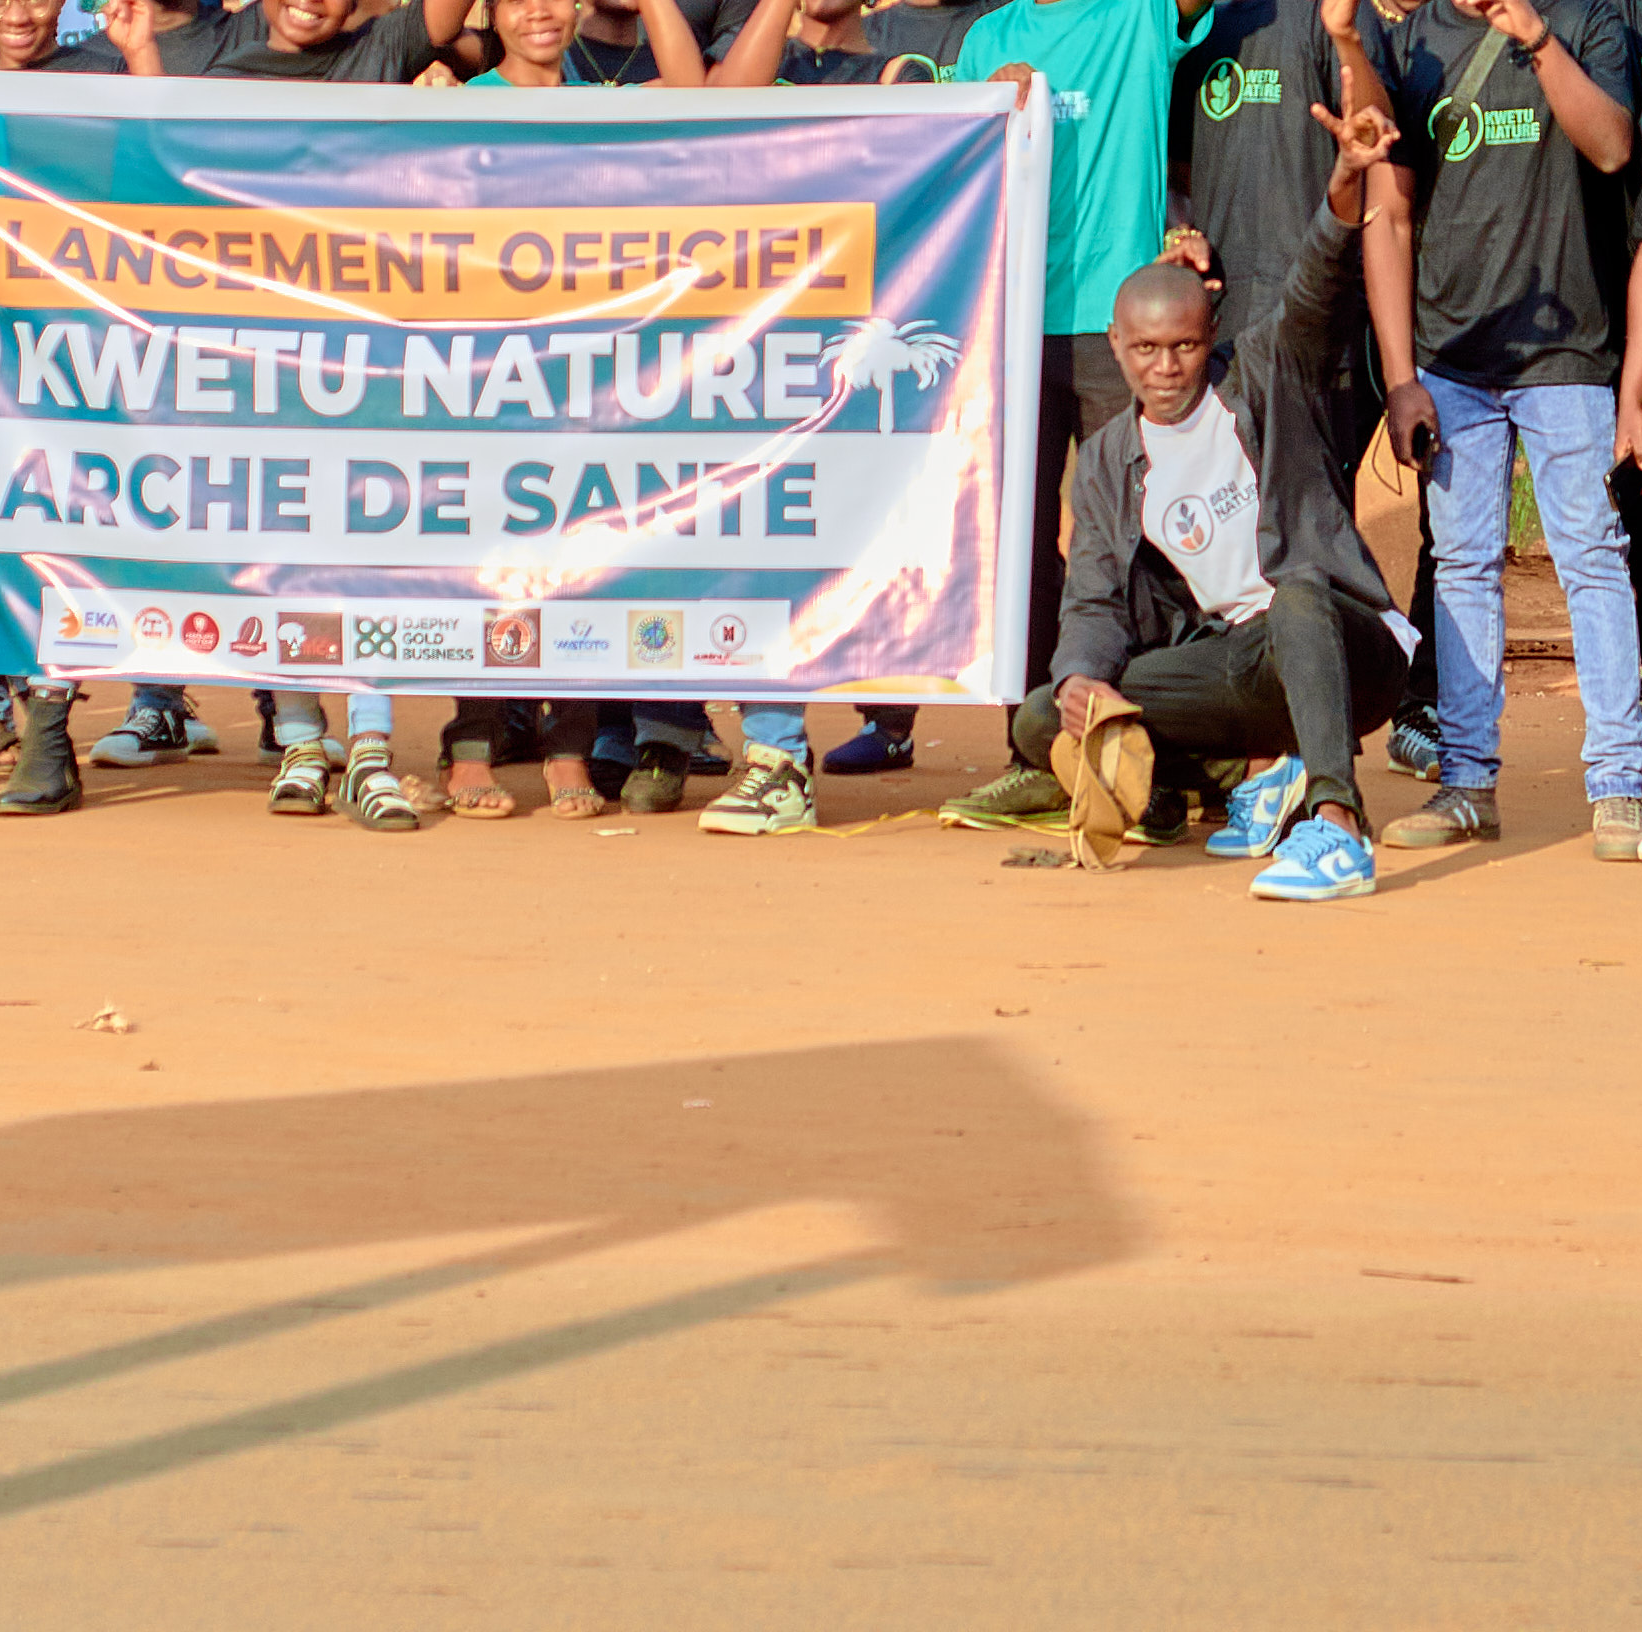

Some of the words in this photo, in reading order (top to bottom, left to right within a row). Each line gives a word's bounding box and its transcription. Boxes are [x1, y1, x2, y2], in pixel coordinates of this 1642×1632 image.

[1484, 108, 1534, 125] KWETU
[1485, 122, 1540, 140] NATURE
[6, 220, 475, 293] LANCEMENT
[498, 227, 847, 293] OFFICIEL
[13, 321, 371, 416] KWETU
[402, 331, 824, 419] NATURE
[345, 458, 471, 535] DE
[500, 460, 818, 537] SANTE
[83, 611, 119, 629] EKA
[403, 617, 461, 632] DJEPHY
[403, 632, 445, 646] GOLD
[403, 648, 475, 662] BUSINESS
